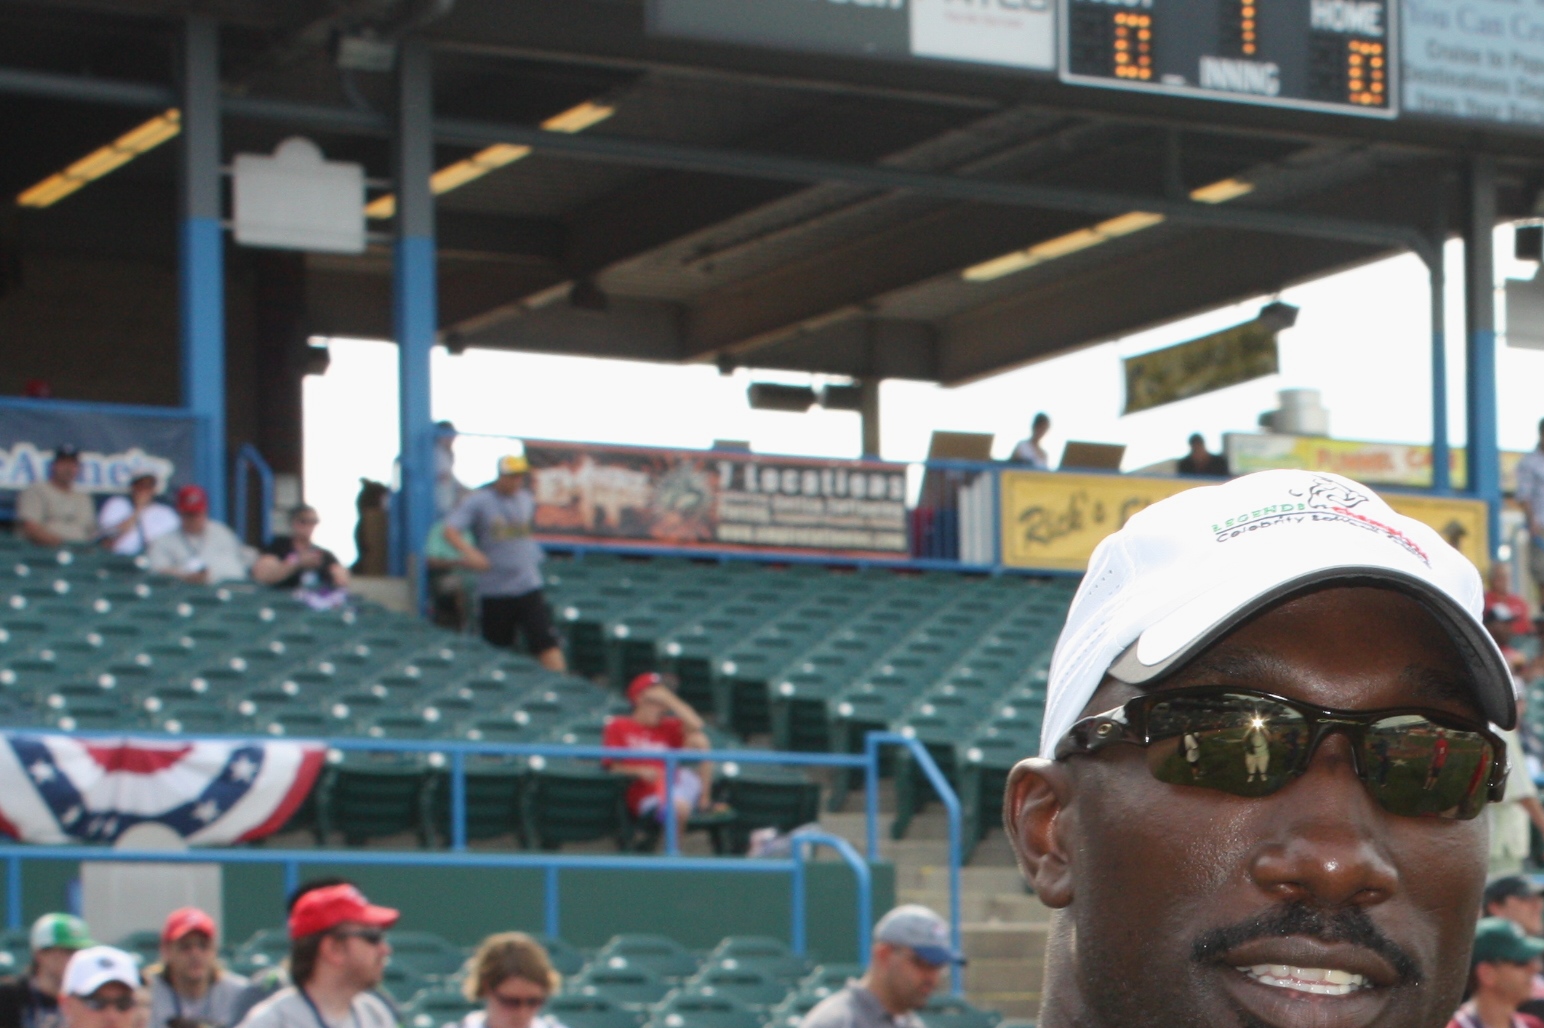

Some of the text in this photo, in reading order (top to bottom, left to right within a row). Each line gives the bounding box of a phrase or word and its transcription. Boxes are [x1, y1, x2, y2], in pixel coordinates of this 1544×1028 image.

[1311, 1, 1384, 37] HOME
[1114, 12, 1151, 80] 0
[1200, 55, 1281, 96] INNING
[1349, 40, 1384, 104] 0
[1211, 503, 1305, 533] LEGENDS
[1216, 514, 1304, 543] Celebrity
